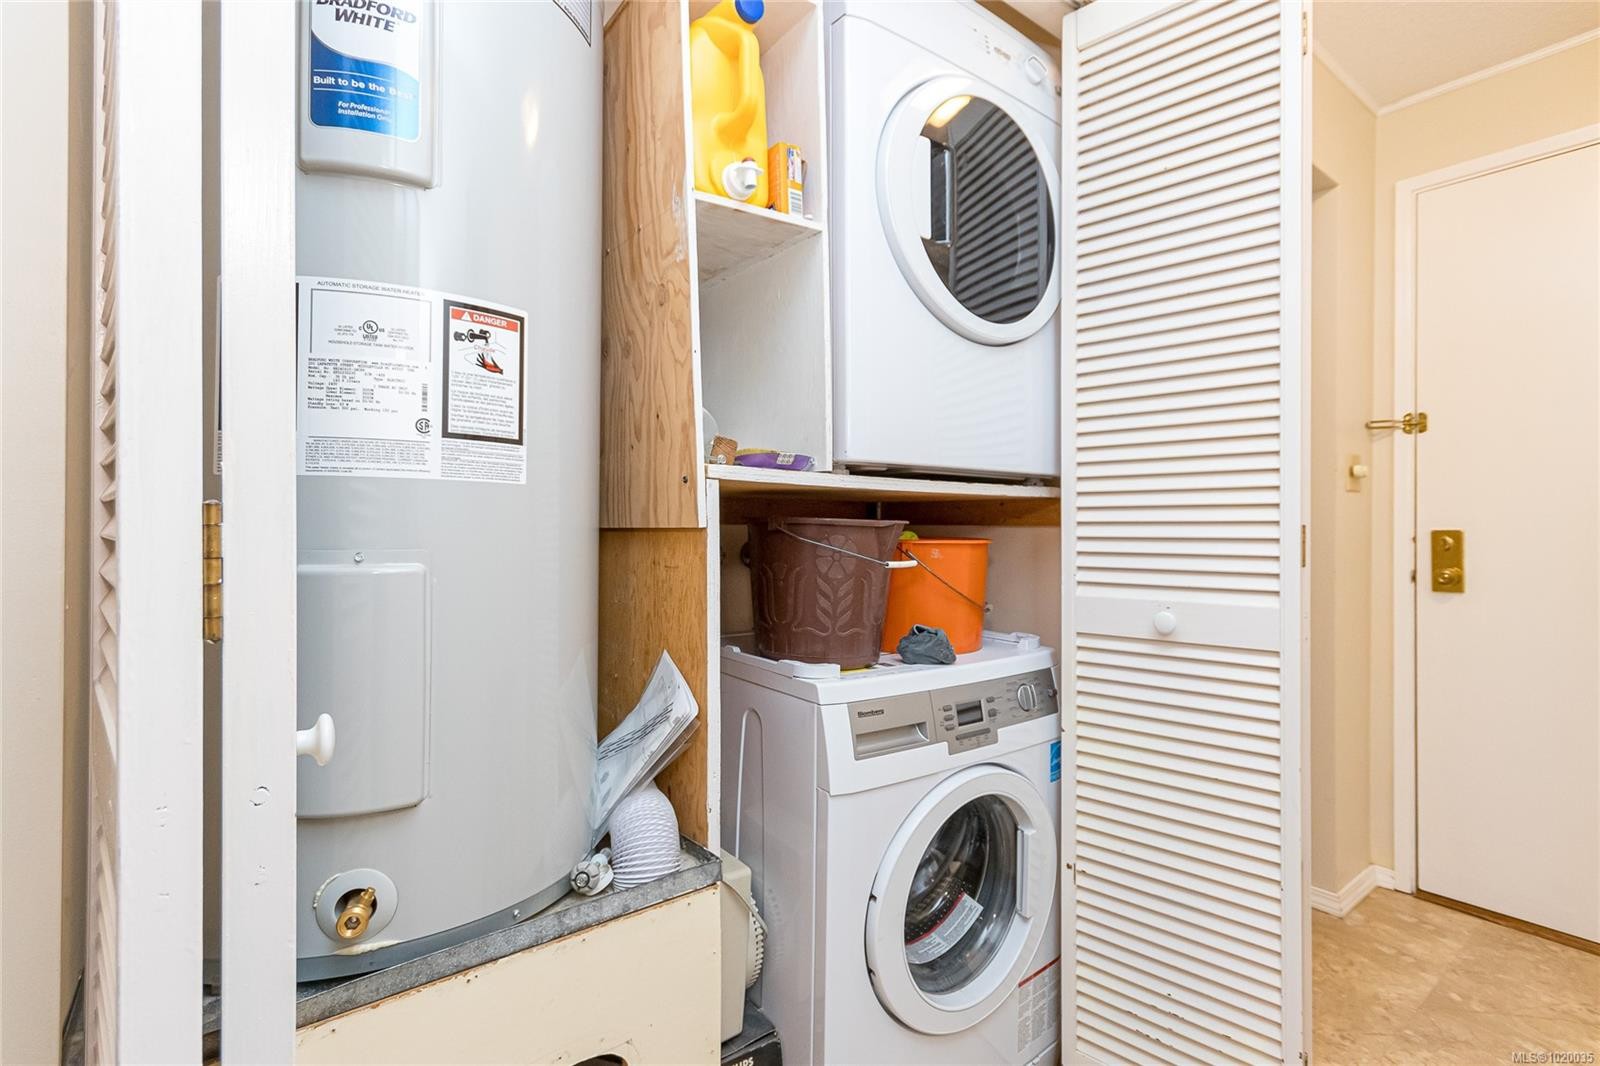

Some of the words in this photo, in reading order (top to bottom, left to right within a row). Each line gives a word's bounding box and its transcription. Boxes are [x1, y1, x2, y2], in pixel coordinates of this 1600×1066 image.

[335, 8, 395, 32] WHITE
[313, 75, 336, 85] Built
[338, 78, 349, 86] to
[352, 79, 366, 89] be
[368, 82, 386, 93] the
[337, 108, 376, 119] Installation
[350, 102, 391, 115] Professiona
[317, 280, 351, 288] AUTOMATIC
[352, 283, 380, 291] STORAGE
[381, 286, 401, 294] WATER
[472, 314, 508, 328] DANGER
